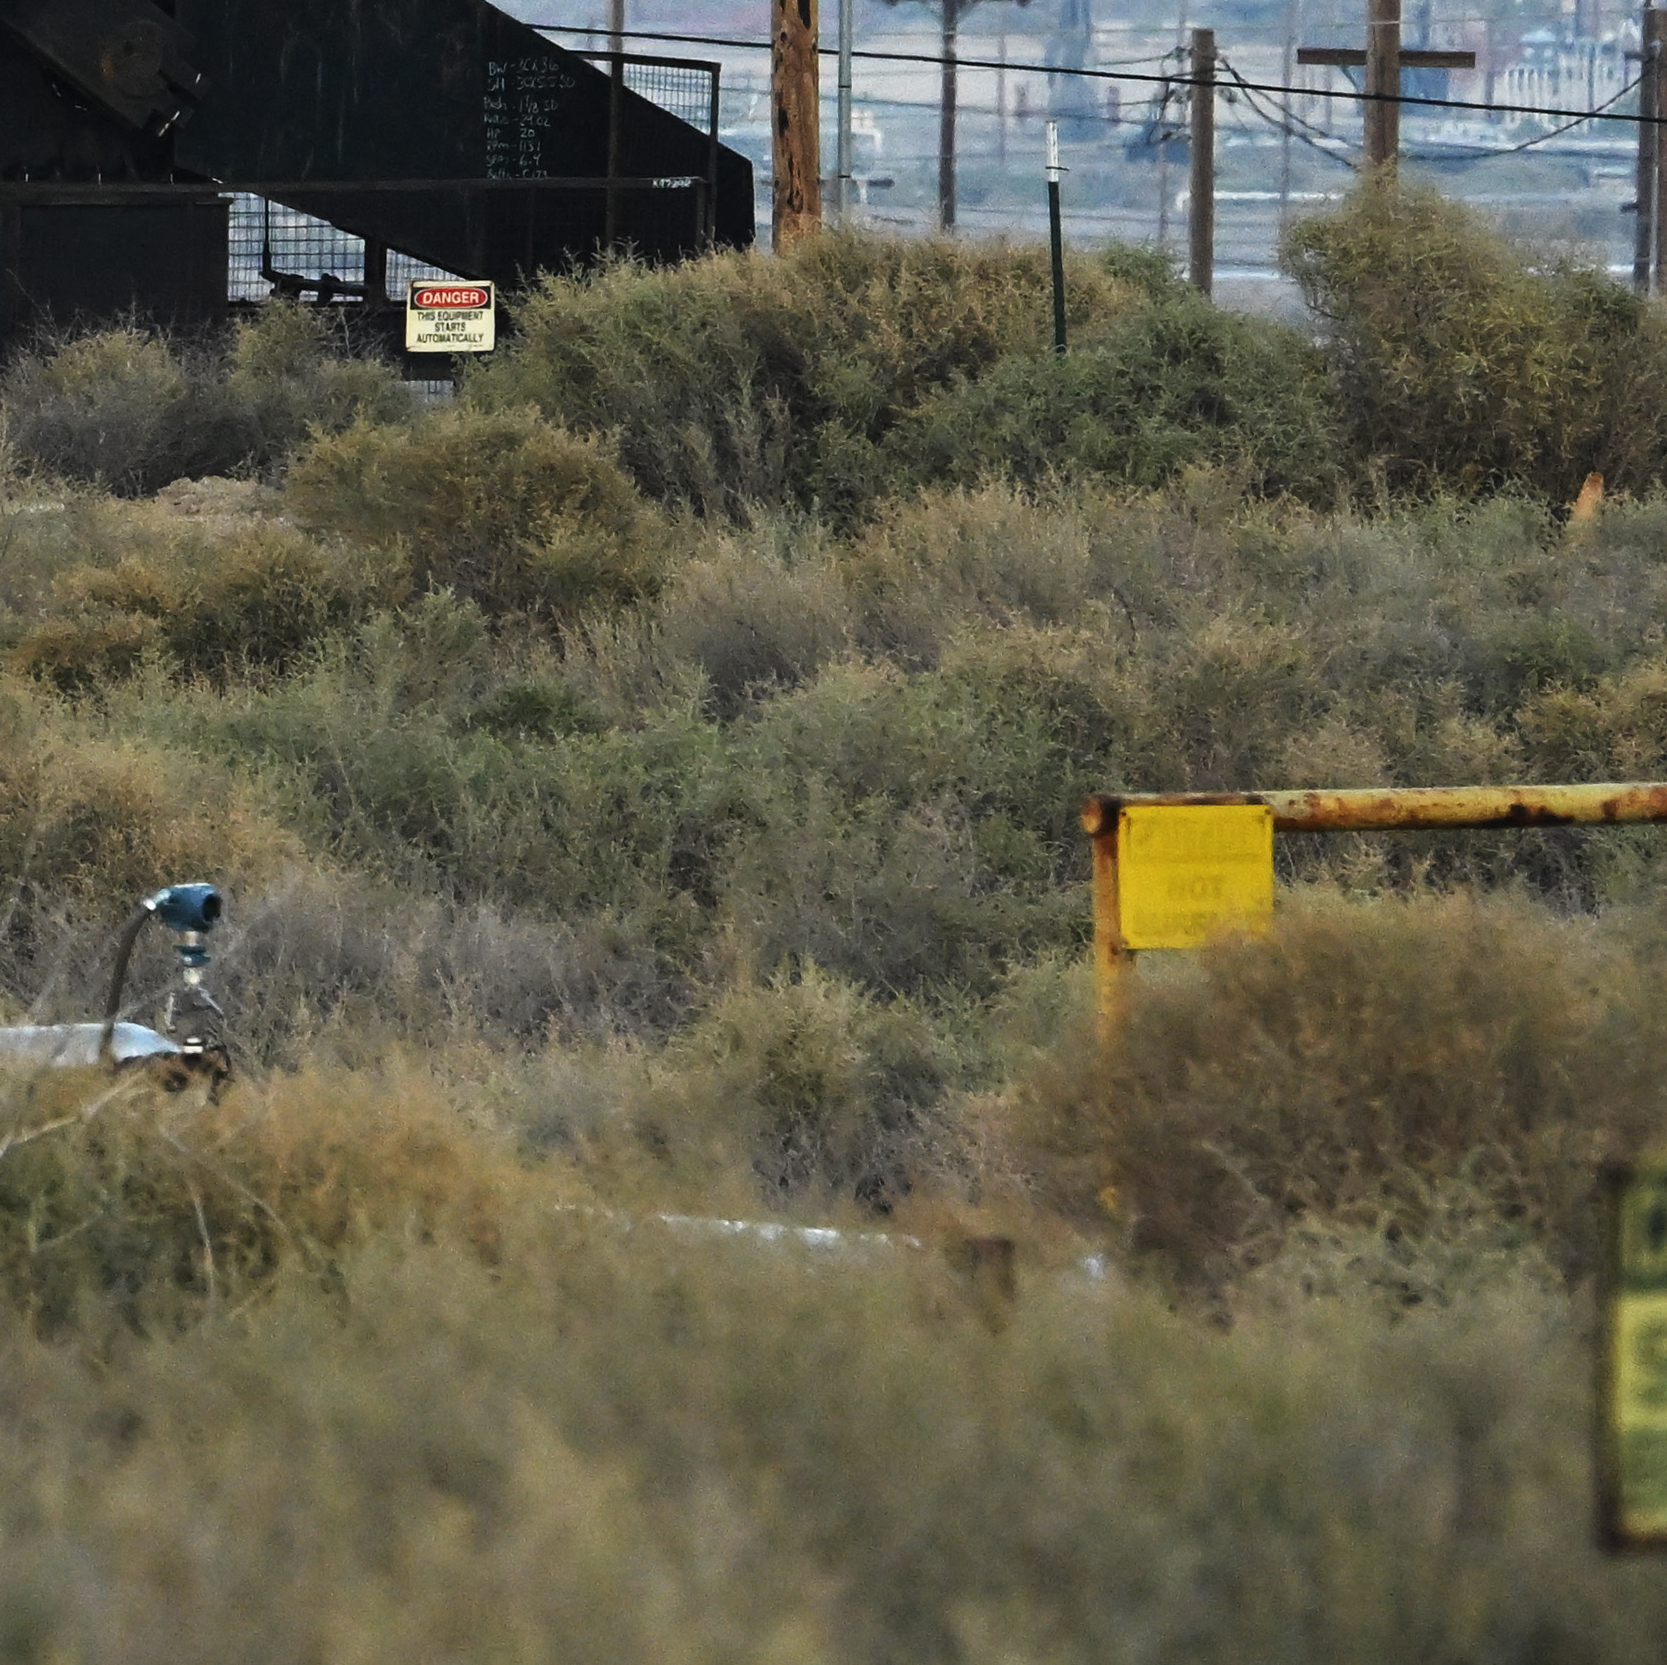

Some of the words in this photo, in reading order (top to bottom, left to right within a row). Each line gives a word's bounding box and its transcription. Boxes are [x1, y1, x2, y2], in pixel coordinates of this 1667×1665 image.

[422, 291, 479, 305] DANGER
[417, 311, 435, 321] THIS
[437, 311, 484, 321] EQUIPMENT
[434, 322, 465, 332] STARTS
[416, 333, 484, 343] AUTOMATICALLY
